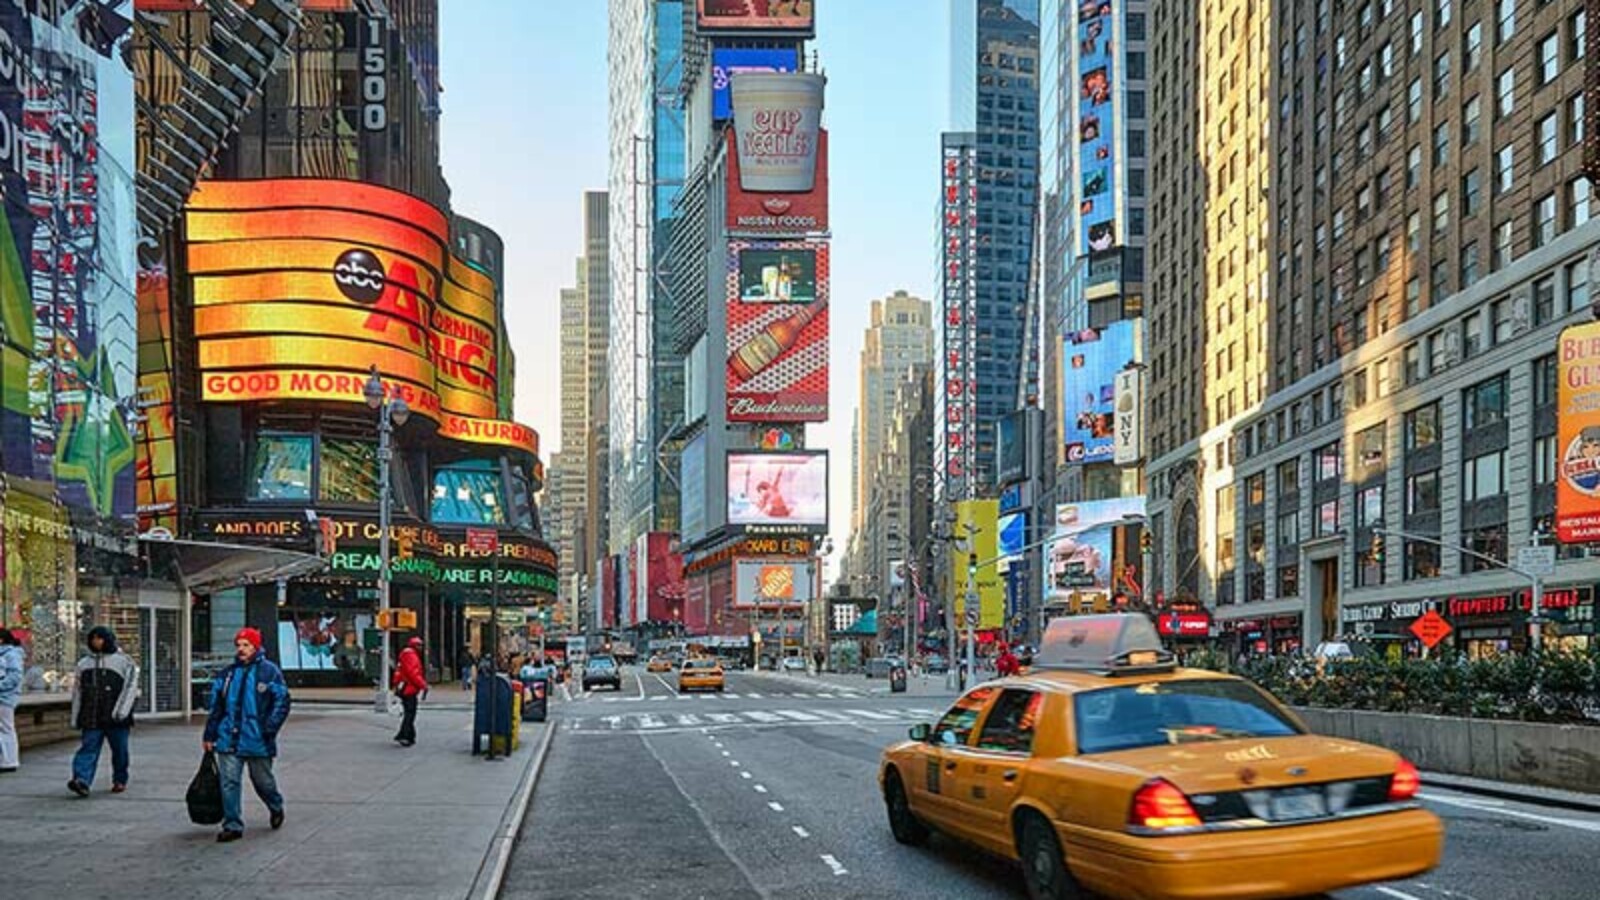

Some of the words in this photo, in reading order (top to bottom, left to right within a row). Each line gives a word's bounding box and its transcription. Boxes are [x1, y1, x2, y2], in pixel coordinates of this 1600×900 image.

[364, 19, 385, 131] 1500
[778, 216, 816, 226] FOODS
[336, 261, 383, 290] abc
[206, 375, 280, 396] GOOD
[289, 374, 414, 403] MORNNG
[731, 397, 827, 416] Budweiser
[745, 523, 809, 534] Panasonic
